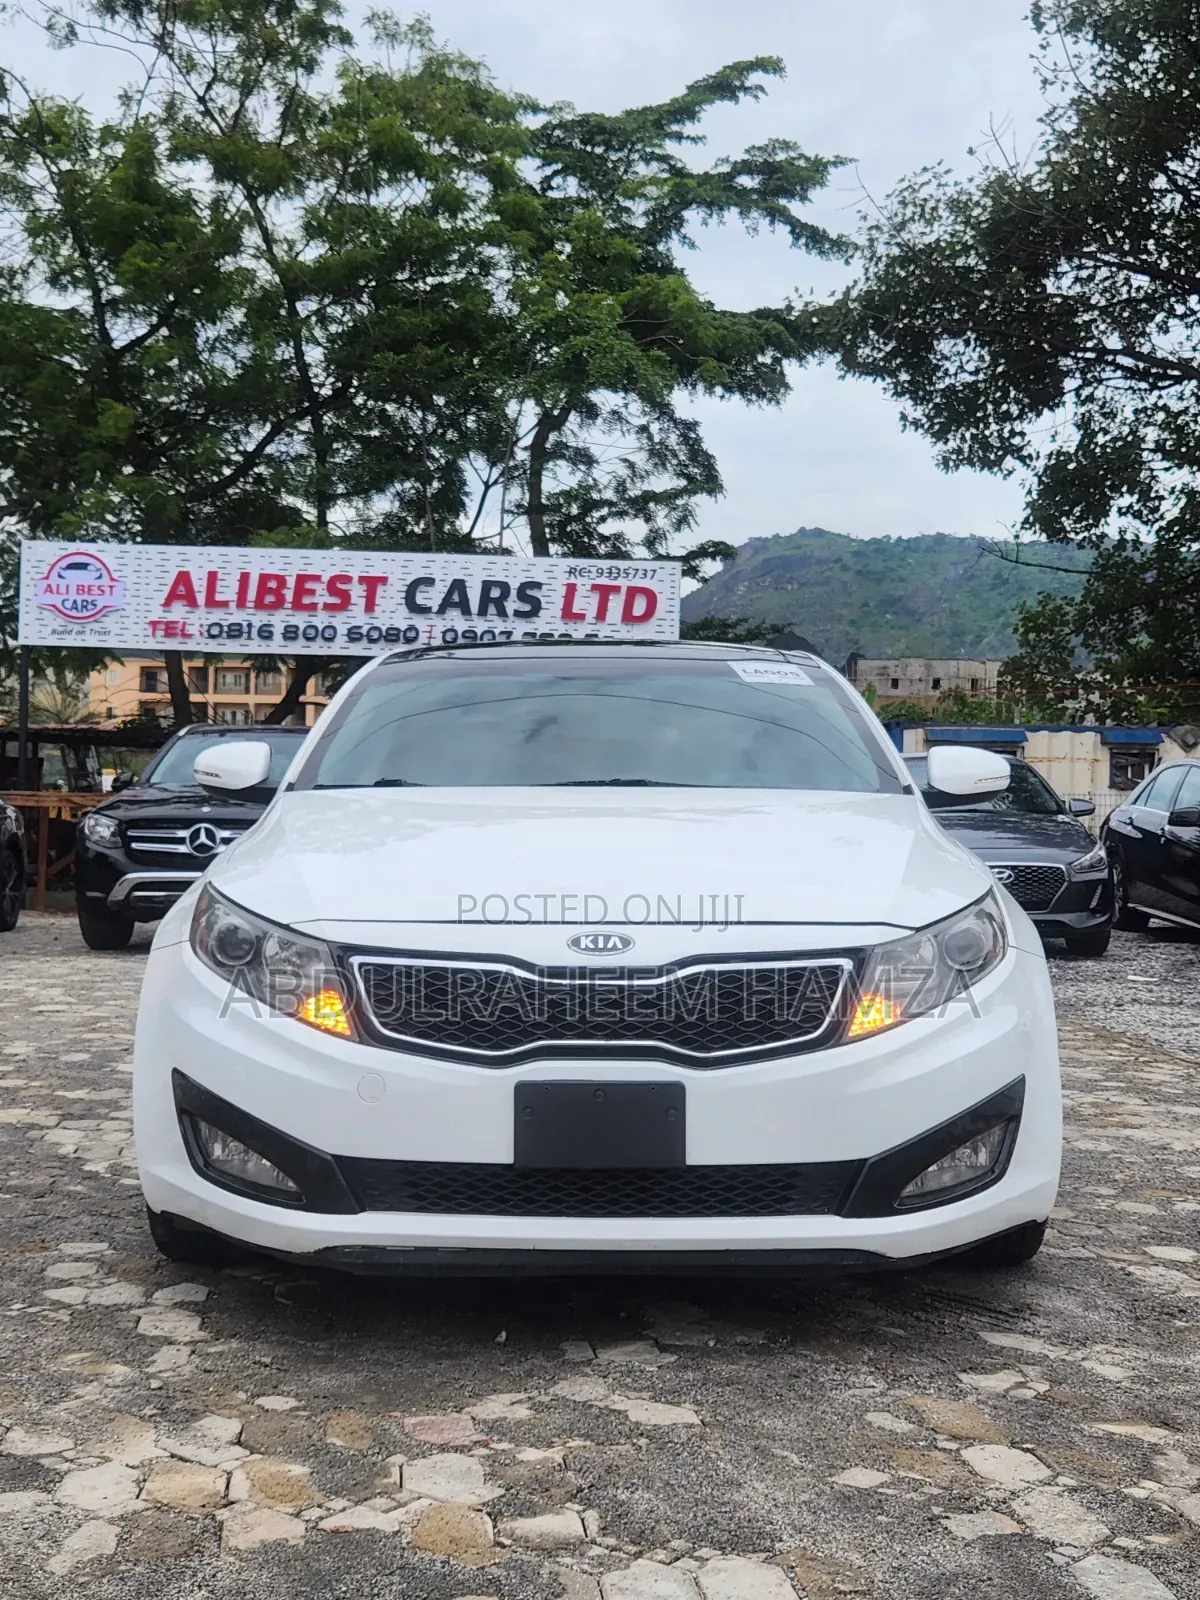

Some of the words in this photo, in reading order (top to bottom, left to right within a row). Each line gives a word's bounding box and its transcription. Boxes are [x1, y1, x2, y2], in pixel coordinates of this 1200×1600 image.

[595, 567, 657, 580] 9335737
[43, 583, 69, 595] ALI
[76, 584, 117, 597] BEST
[162, 571, 388, 613] ALIBEST
[404, 576, 543, 619] CARS
[560, 582, 658, 624] LTD
[61, 598, 98, 613] CARS
[50, 628, 74, 636] Build
[89, 628, 112, 637] Trust
[206, 622, 274, 641] 0816
[283, 624, 338, 642] 800
[346, 625, 419, 643] 6080
[742, 668, 801, 677] LAGOS
[580, 935, 623, 949] KIA
